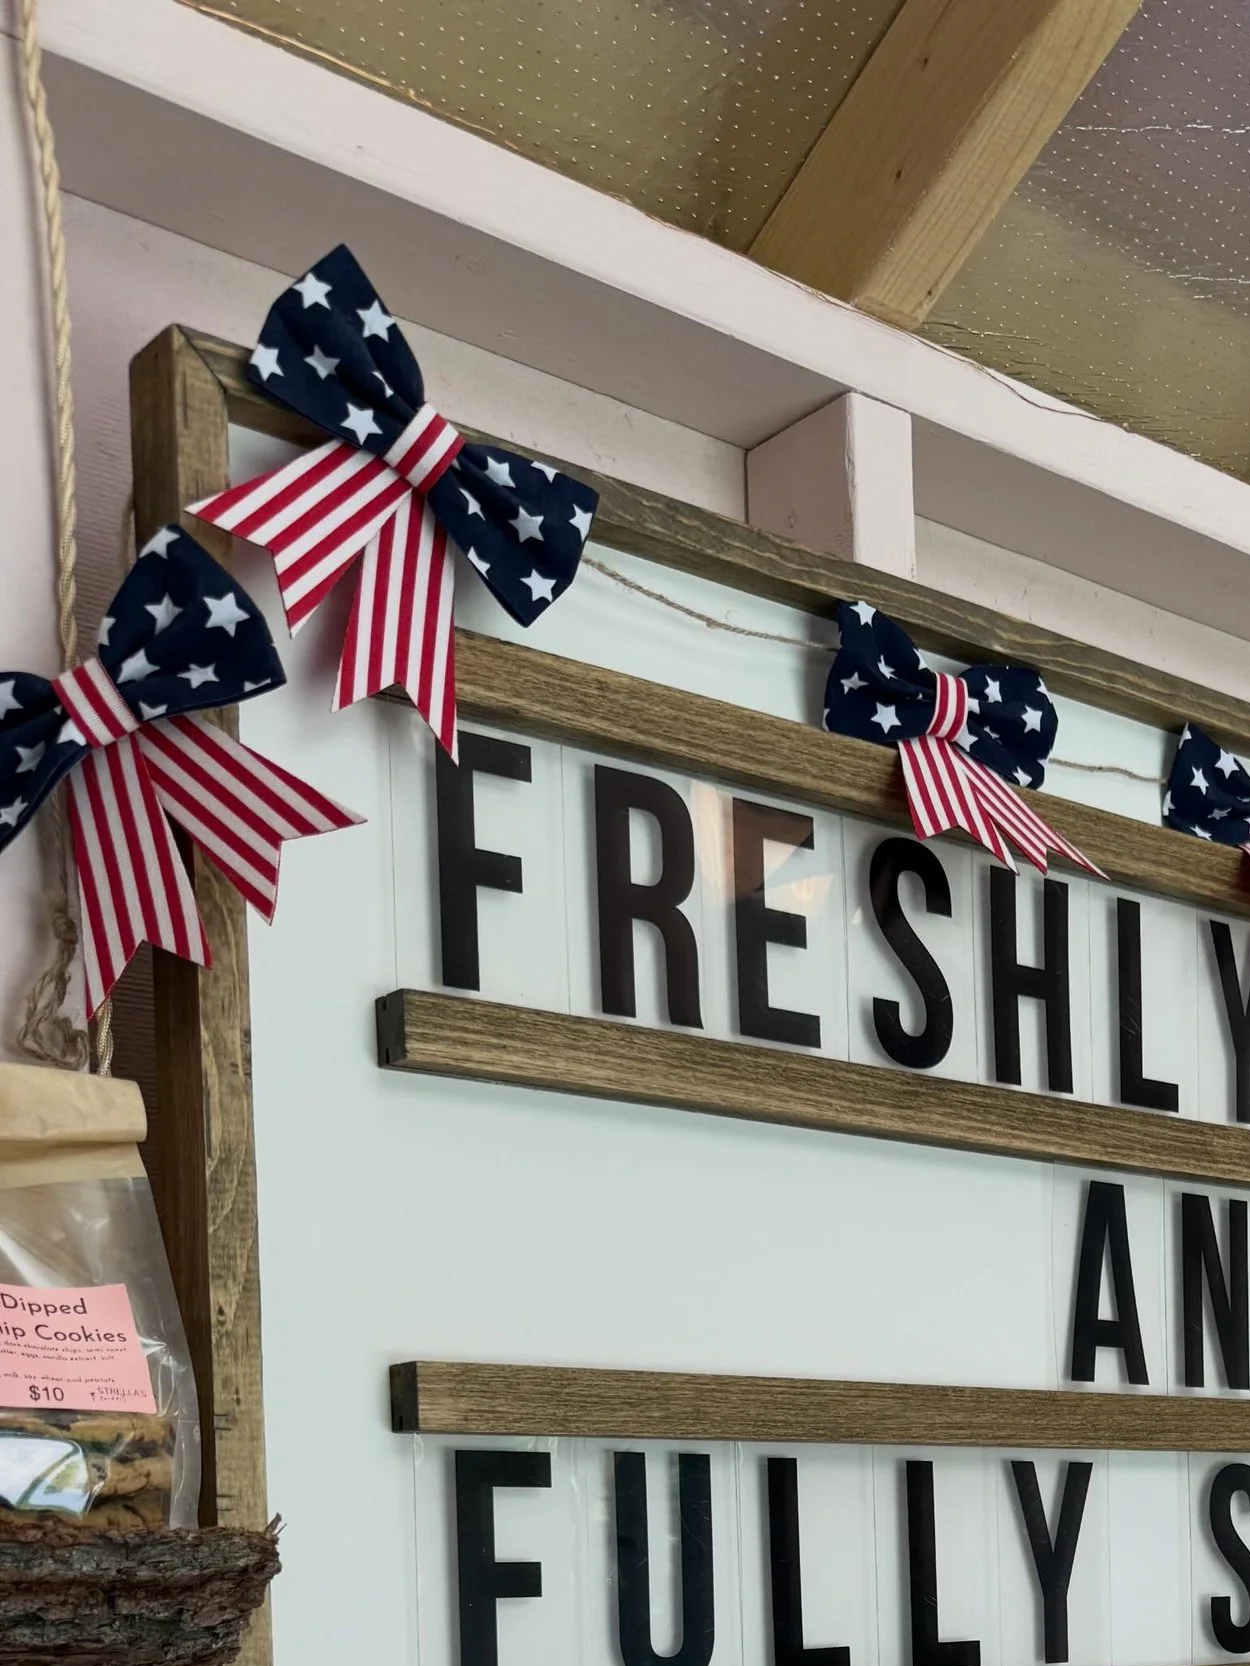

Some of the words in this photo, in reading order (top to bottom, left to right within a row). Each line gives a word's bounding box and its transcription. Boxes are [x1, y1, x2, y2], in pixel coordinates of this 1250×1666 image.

[0, 1293, 87, 1317] Dipped
[34, 1324, 127, 1342] Cookies
[29, 1384, 64, 1402] $10
